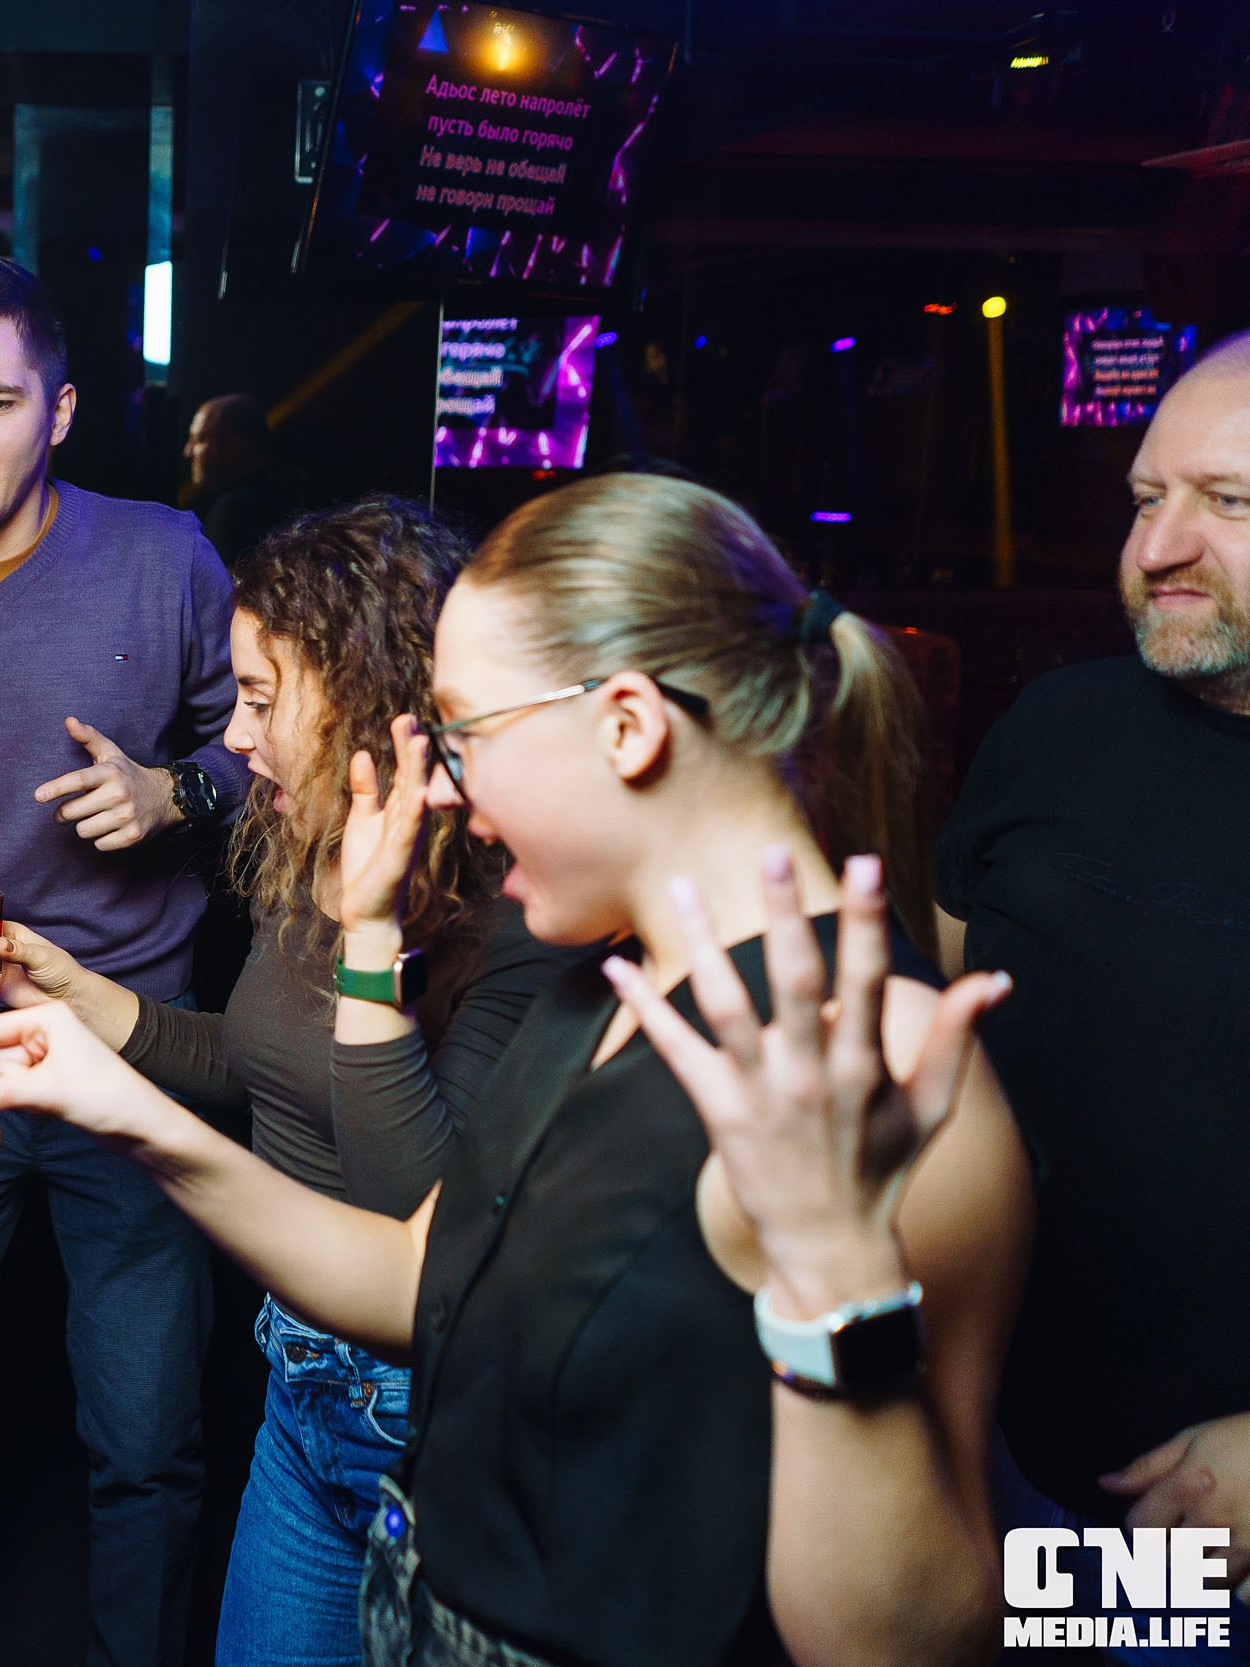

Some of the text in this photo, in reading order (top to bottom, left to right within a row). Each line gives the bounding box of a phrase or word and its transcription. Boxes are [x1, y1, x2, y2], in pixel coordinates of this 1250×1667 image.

[425, 74, 591, 119] Адьос лето напролёт
[428, 115, 574, 151] пусть было горячо
[420, 145, 567, 184] Не верь не обещай
[416, 184, 556, 216] не говори прощай
[437, 394, 495, 415] рощай
